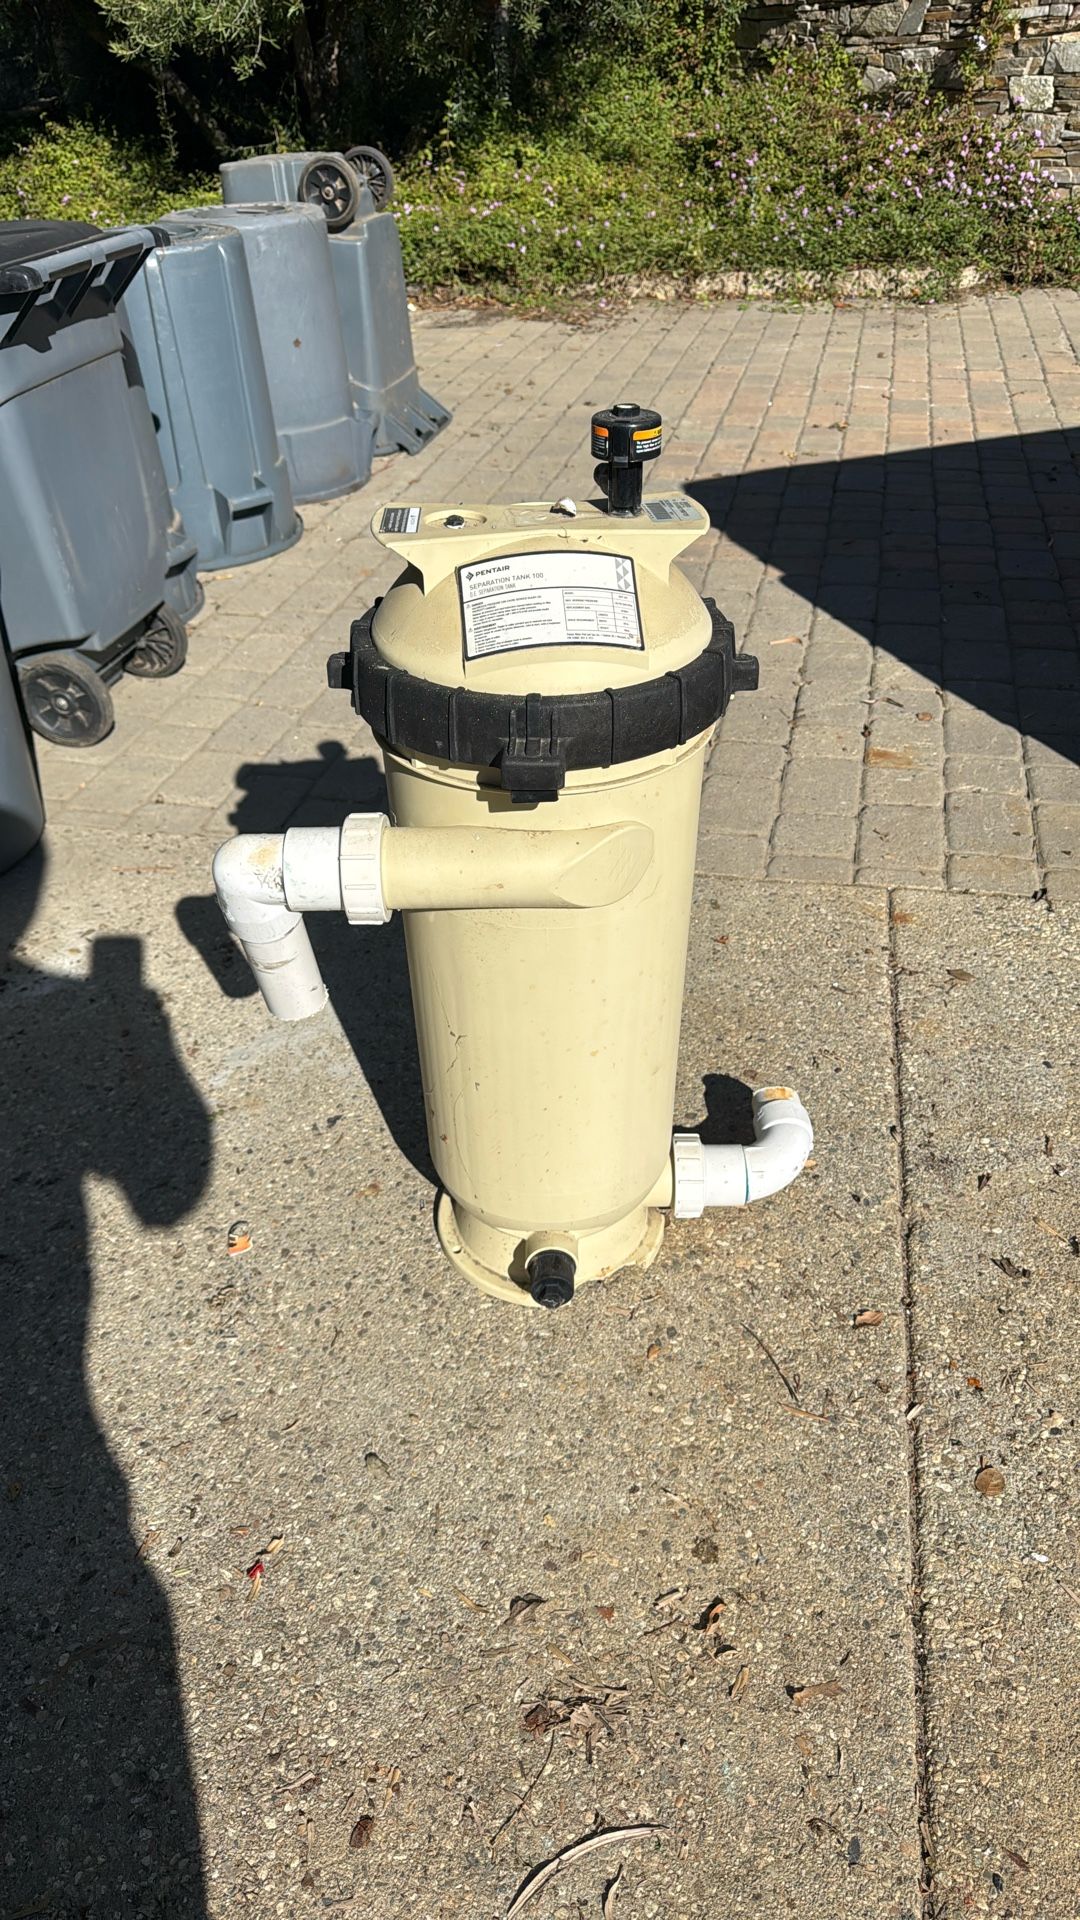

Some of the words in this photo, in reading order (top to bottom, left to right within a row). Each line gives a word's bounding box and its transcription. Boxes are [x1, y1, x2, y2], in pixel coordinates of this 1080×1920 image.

[475, 565, 510, 577] PENTAIR
[469, 577, 510, 590] SEPARATION
[479, 586, 504, 595] SEPARATION
